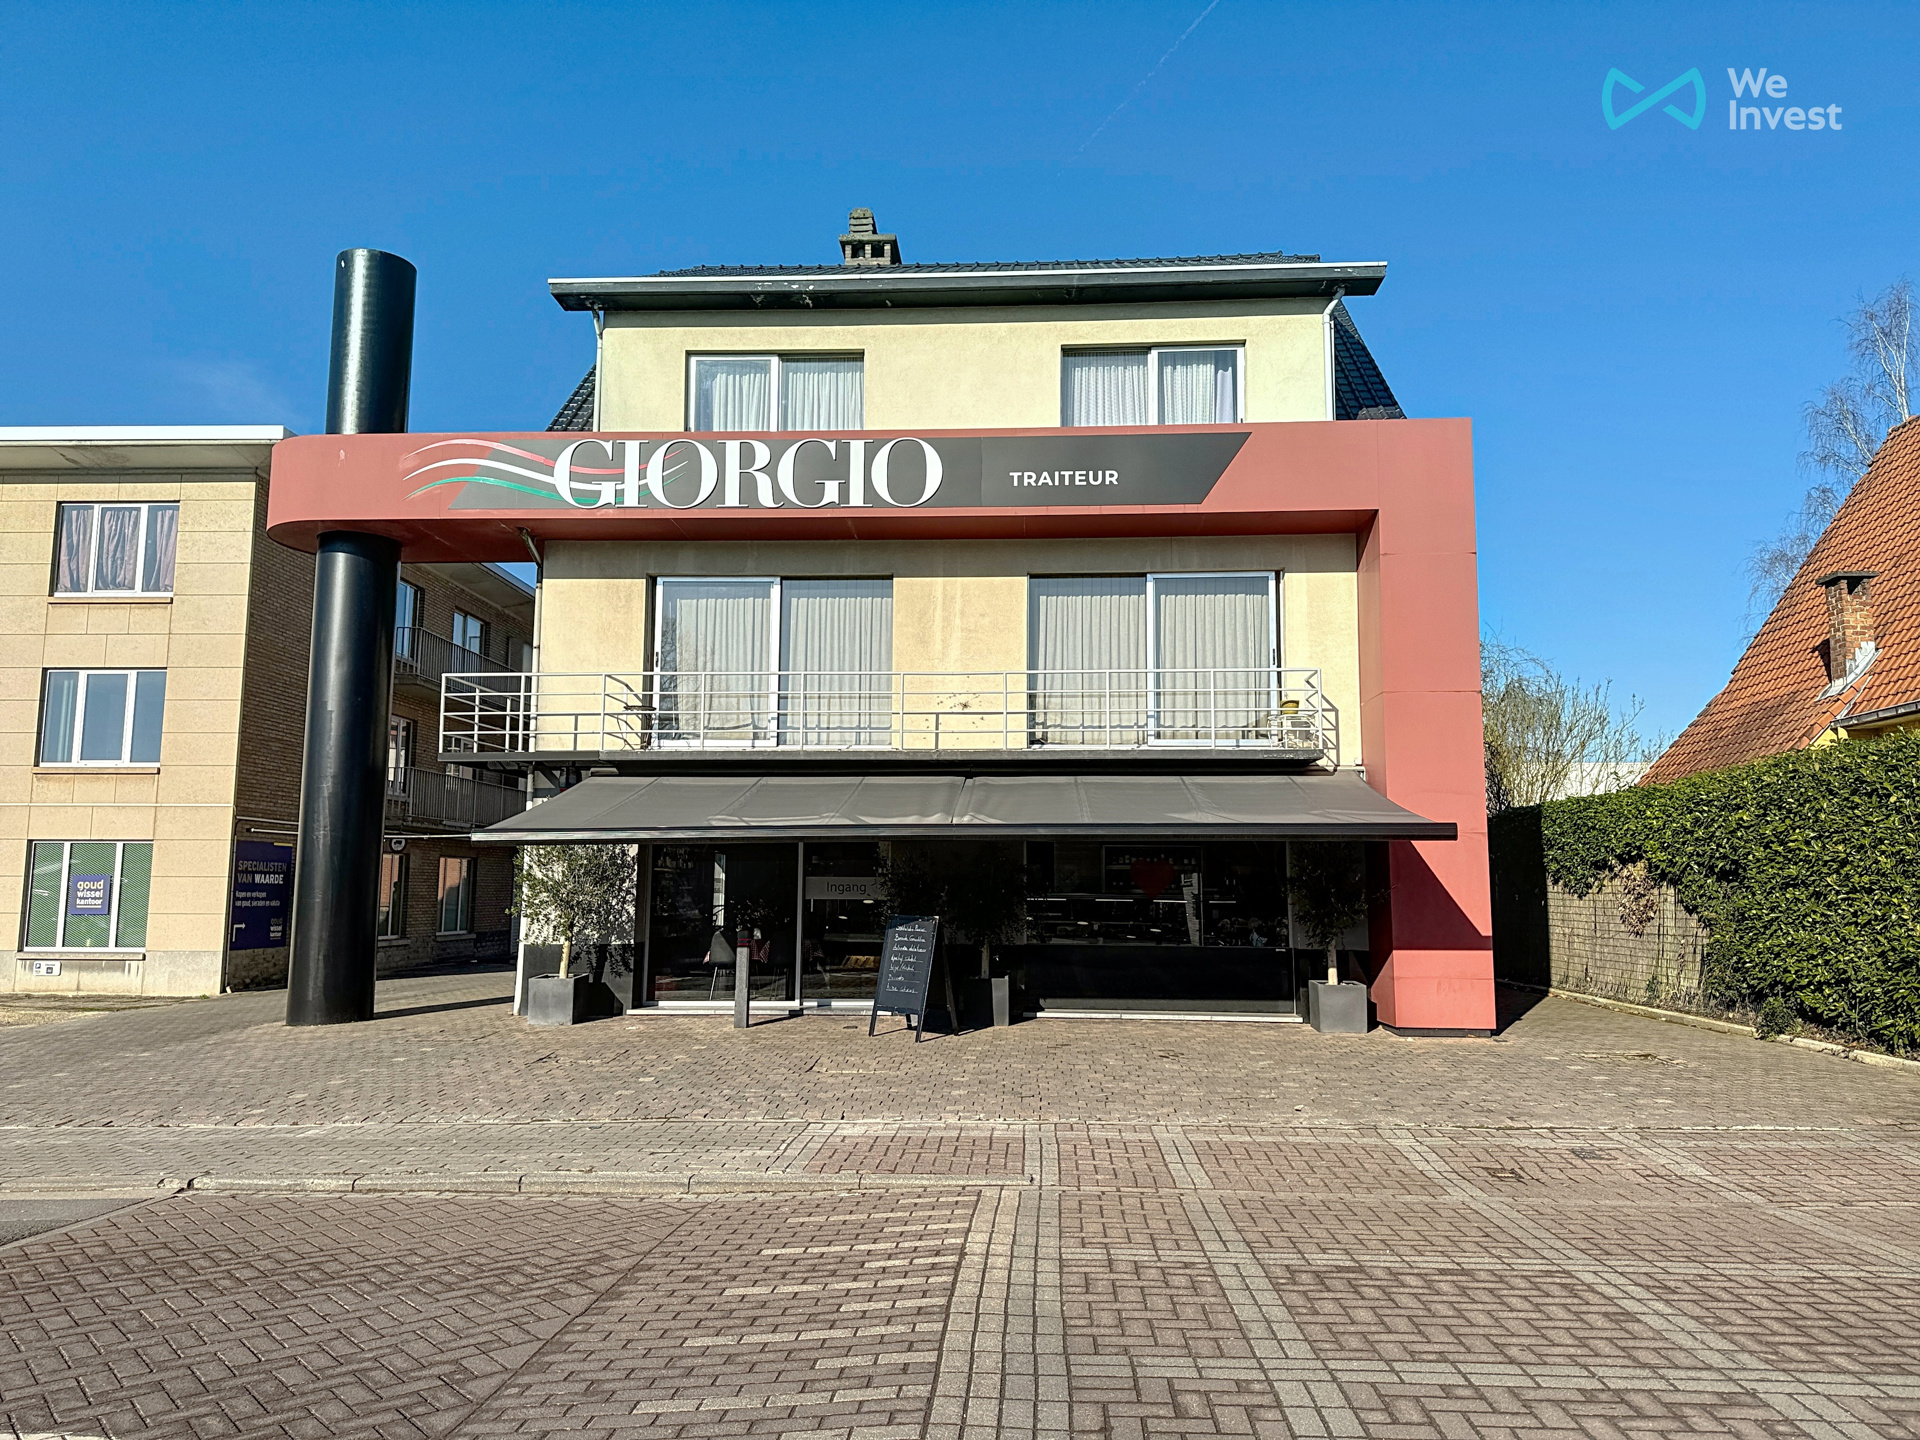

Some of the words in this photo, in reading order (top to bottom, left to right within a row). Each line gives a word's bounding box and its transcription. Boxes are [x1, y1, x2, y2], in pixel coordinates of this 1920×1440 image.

[553, 437, 944, 509] GIORGIO
[1009, 469, 1119, 487] TRAITEUR
[238, 860, 287, 872] SPECIALISTEN
[237, 872, 253, 884] VAN
[254, 873, 284, 884] WAARDE
[77, 879, 104, 891] goud
[826, 881, 867, 895] Ingang
[76, 890, 103, 898] wissel
